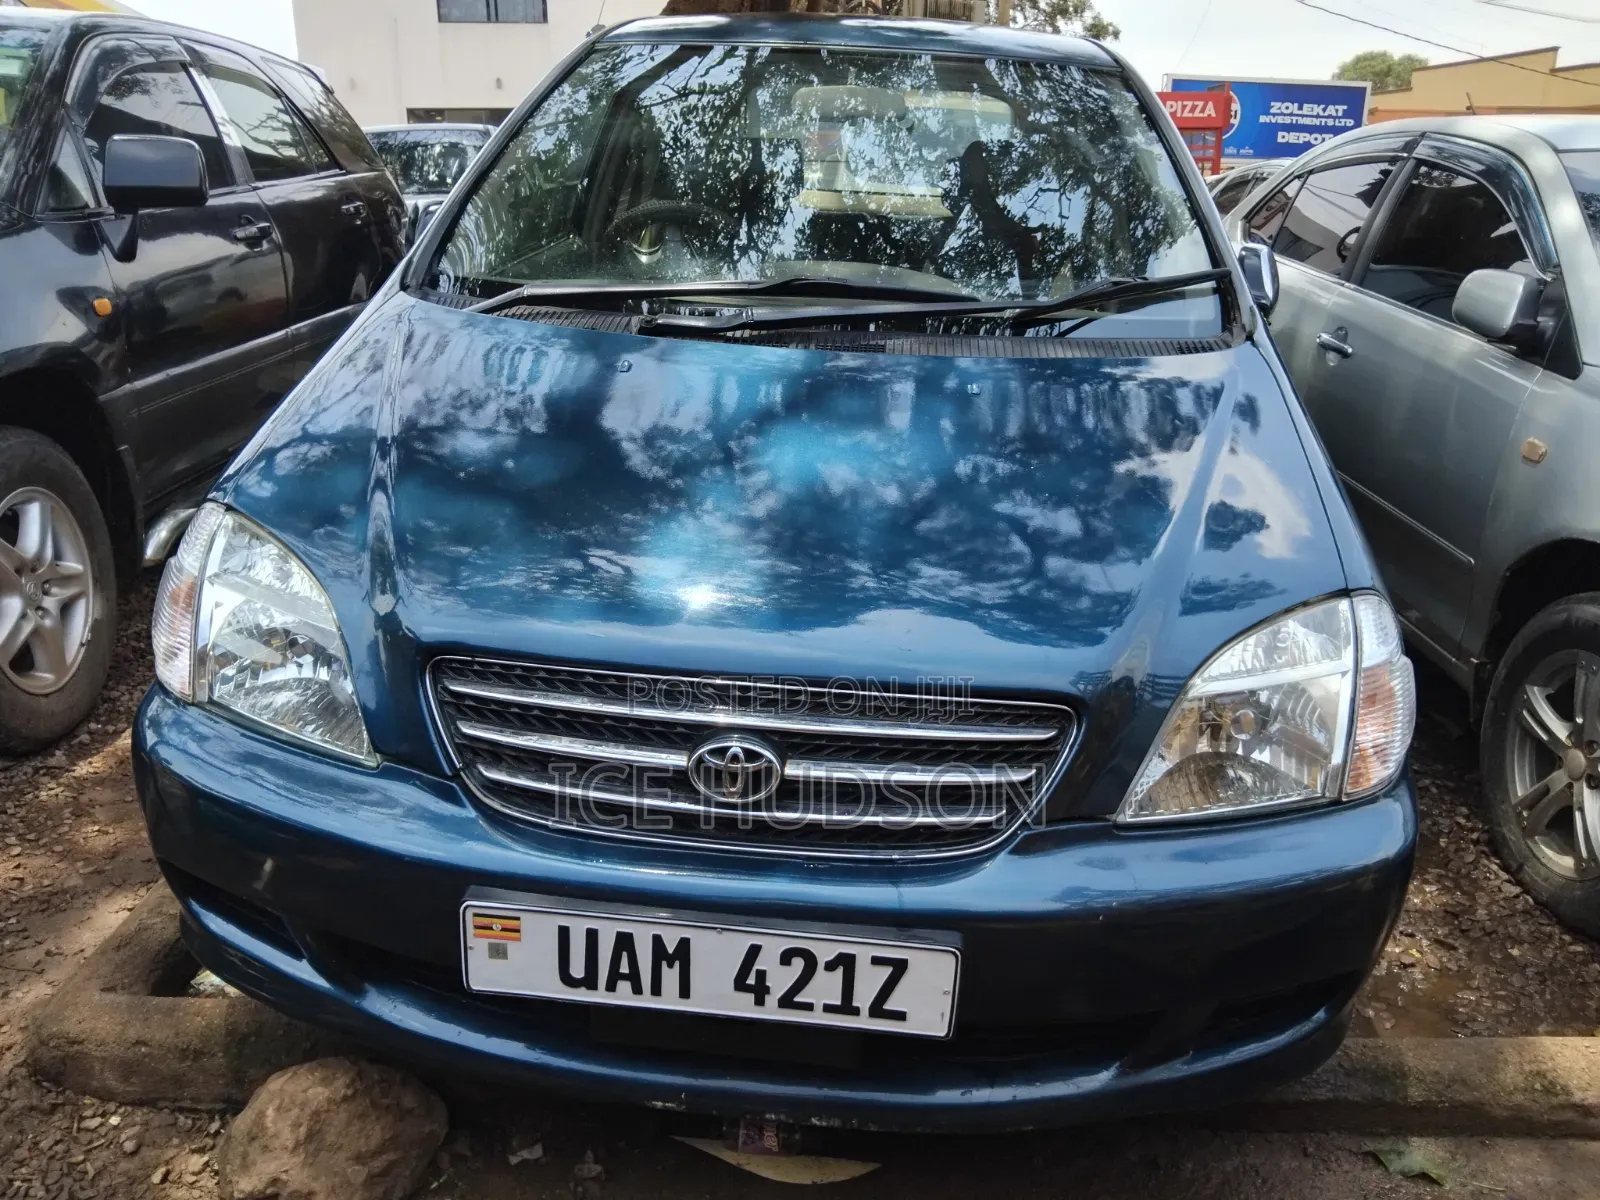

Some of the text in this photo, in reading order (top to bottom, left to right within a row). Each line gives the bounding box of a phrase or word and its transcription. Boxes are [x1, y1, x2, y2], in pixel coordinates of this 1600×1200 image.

[1166, 101, 1216, 118] PIZZA
[1269, 101, 1348, 117] ZOLEKAT
[1259, 114, 1354, 127] INVESTMENTS LTD
[557, 924, 909, 1022] UAM 421Z
